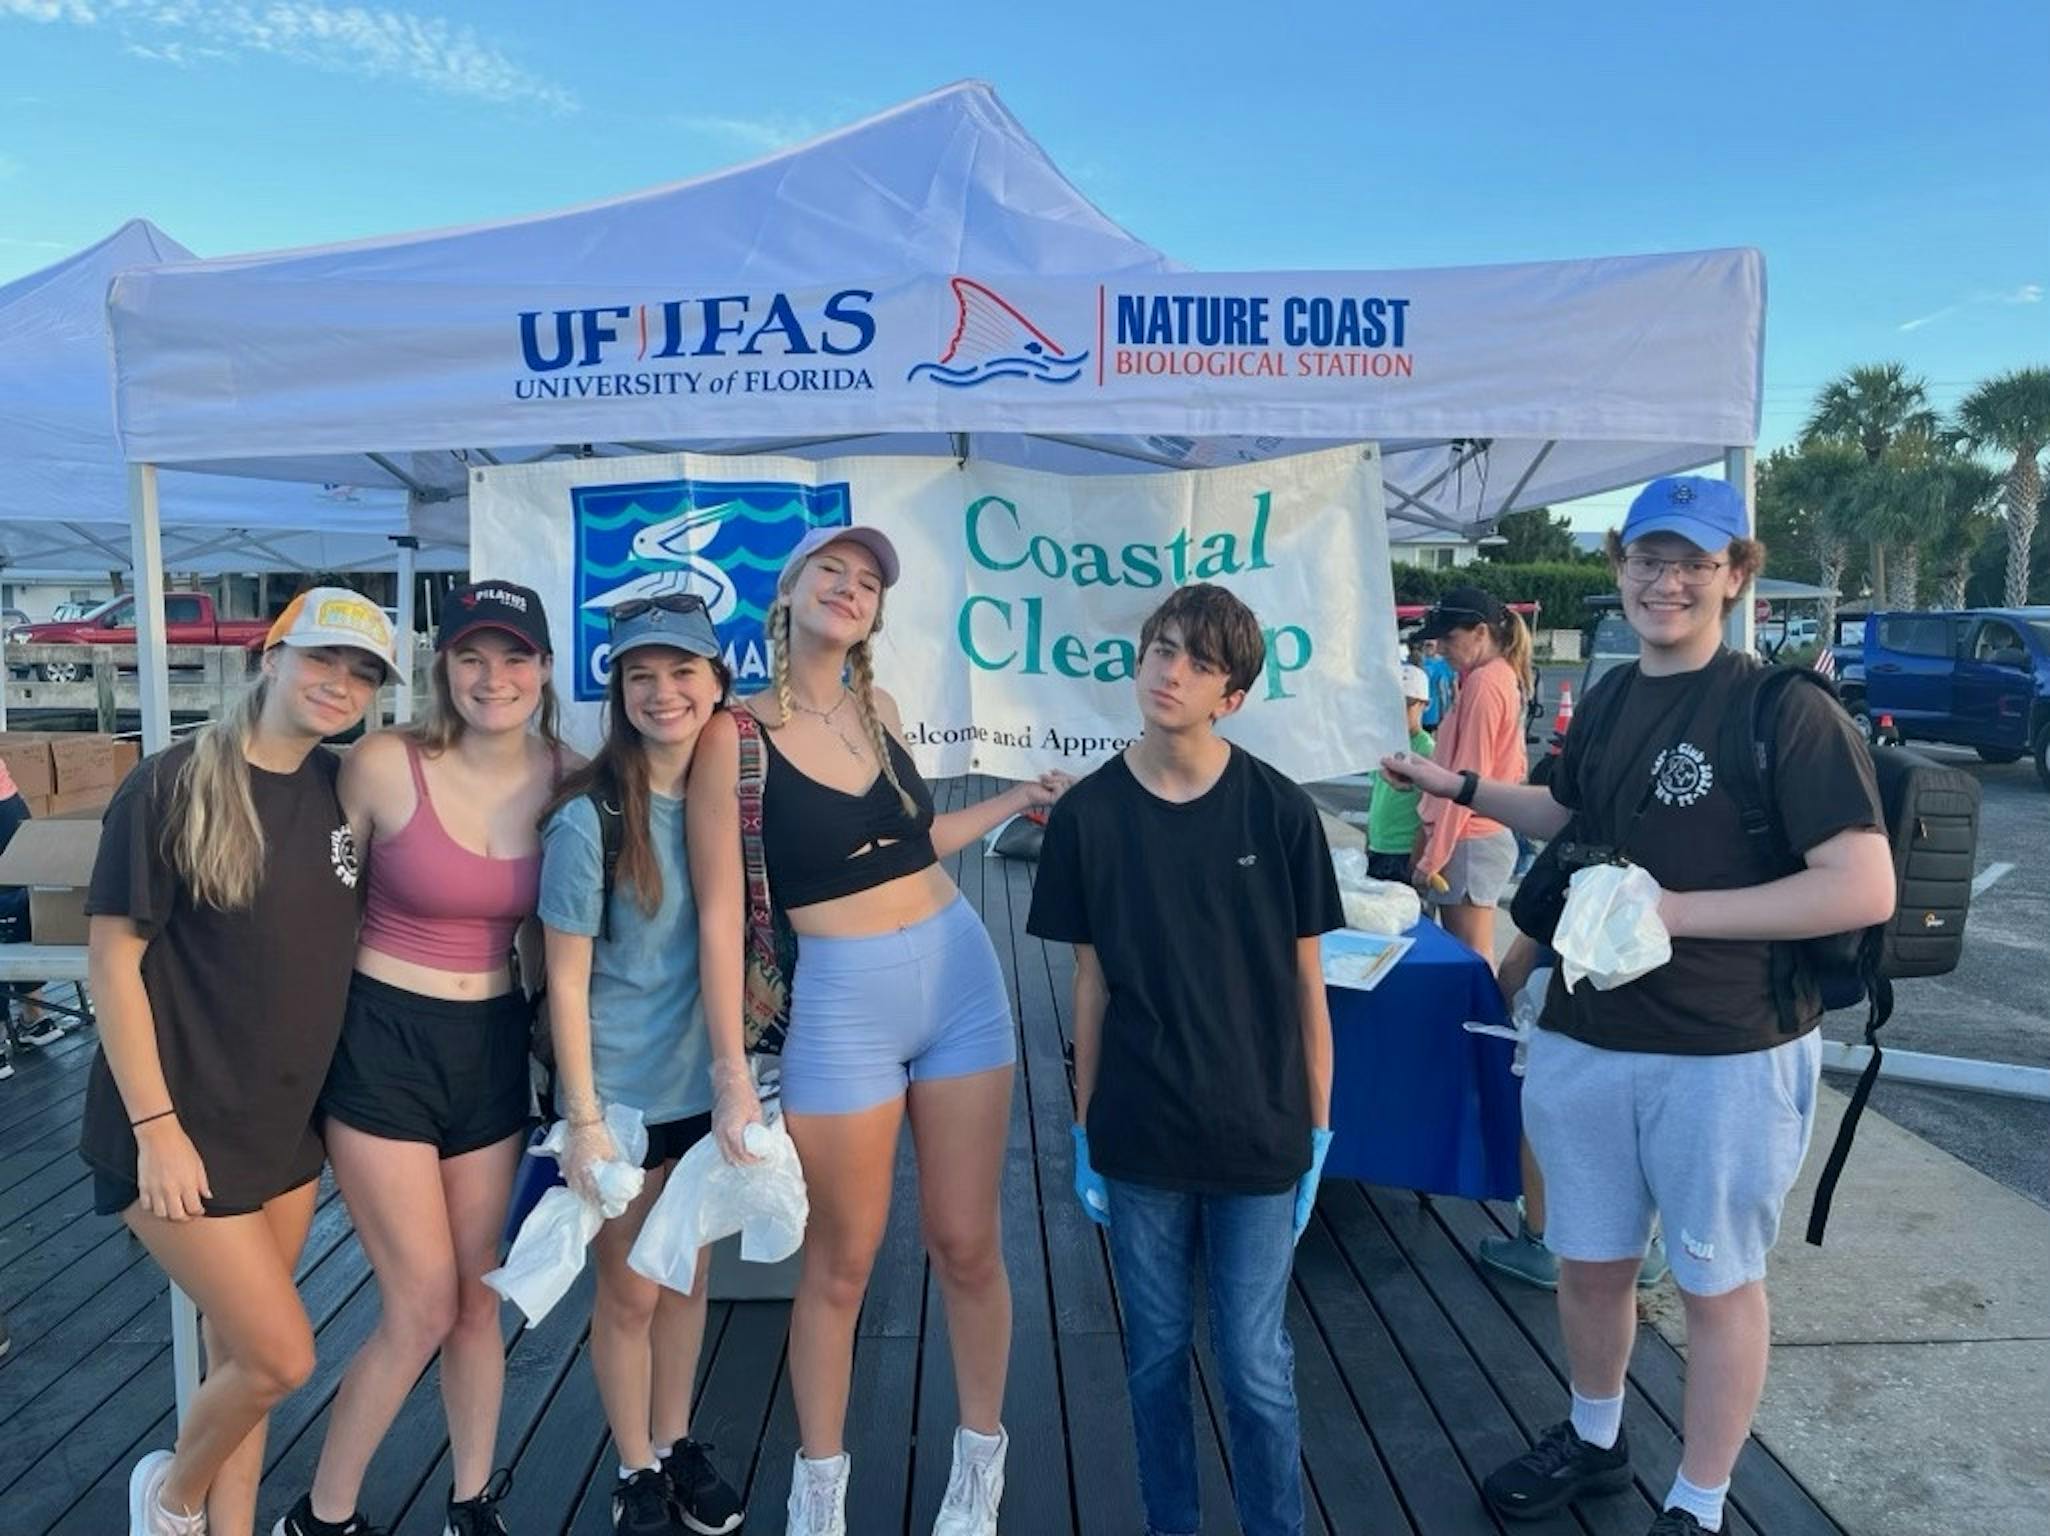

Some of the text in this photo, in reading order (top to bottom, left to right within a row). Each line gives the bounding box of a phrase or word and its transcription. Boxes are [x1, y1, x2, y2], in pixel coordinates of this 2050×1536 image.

[651, 288, 877, 360] IFAS
[1117, 294, 1412, 349] NATURE COAST
[514, 367, 875, 400] UNIVERSITY of FLORIDA
[1115, 350, 1414, 378] BIOLOGICAL STATION
[963, 489, 1274, 589] Coastal
[957, 594, 1313, 701] Cleap
[900, 722, 988, 745] elcome
[993, 725, 1032, 749] and
